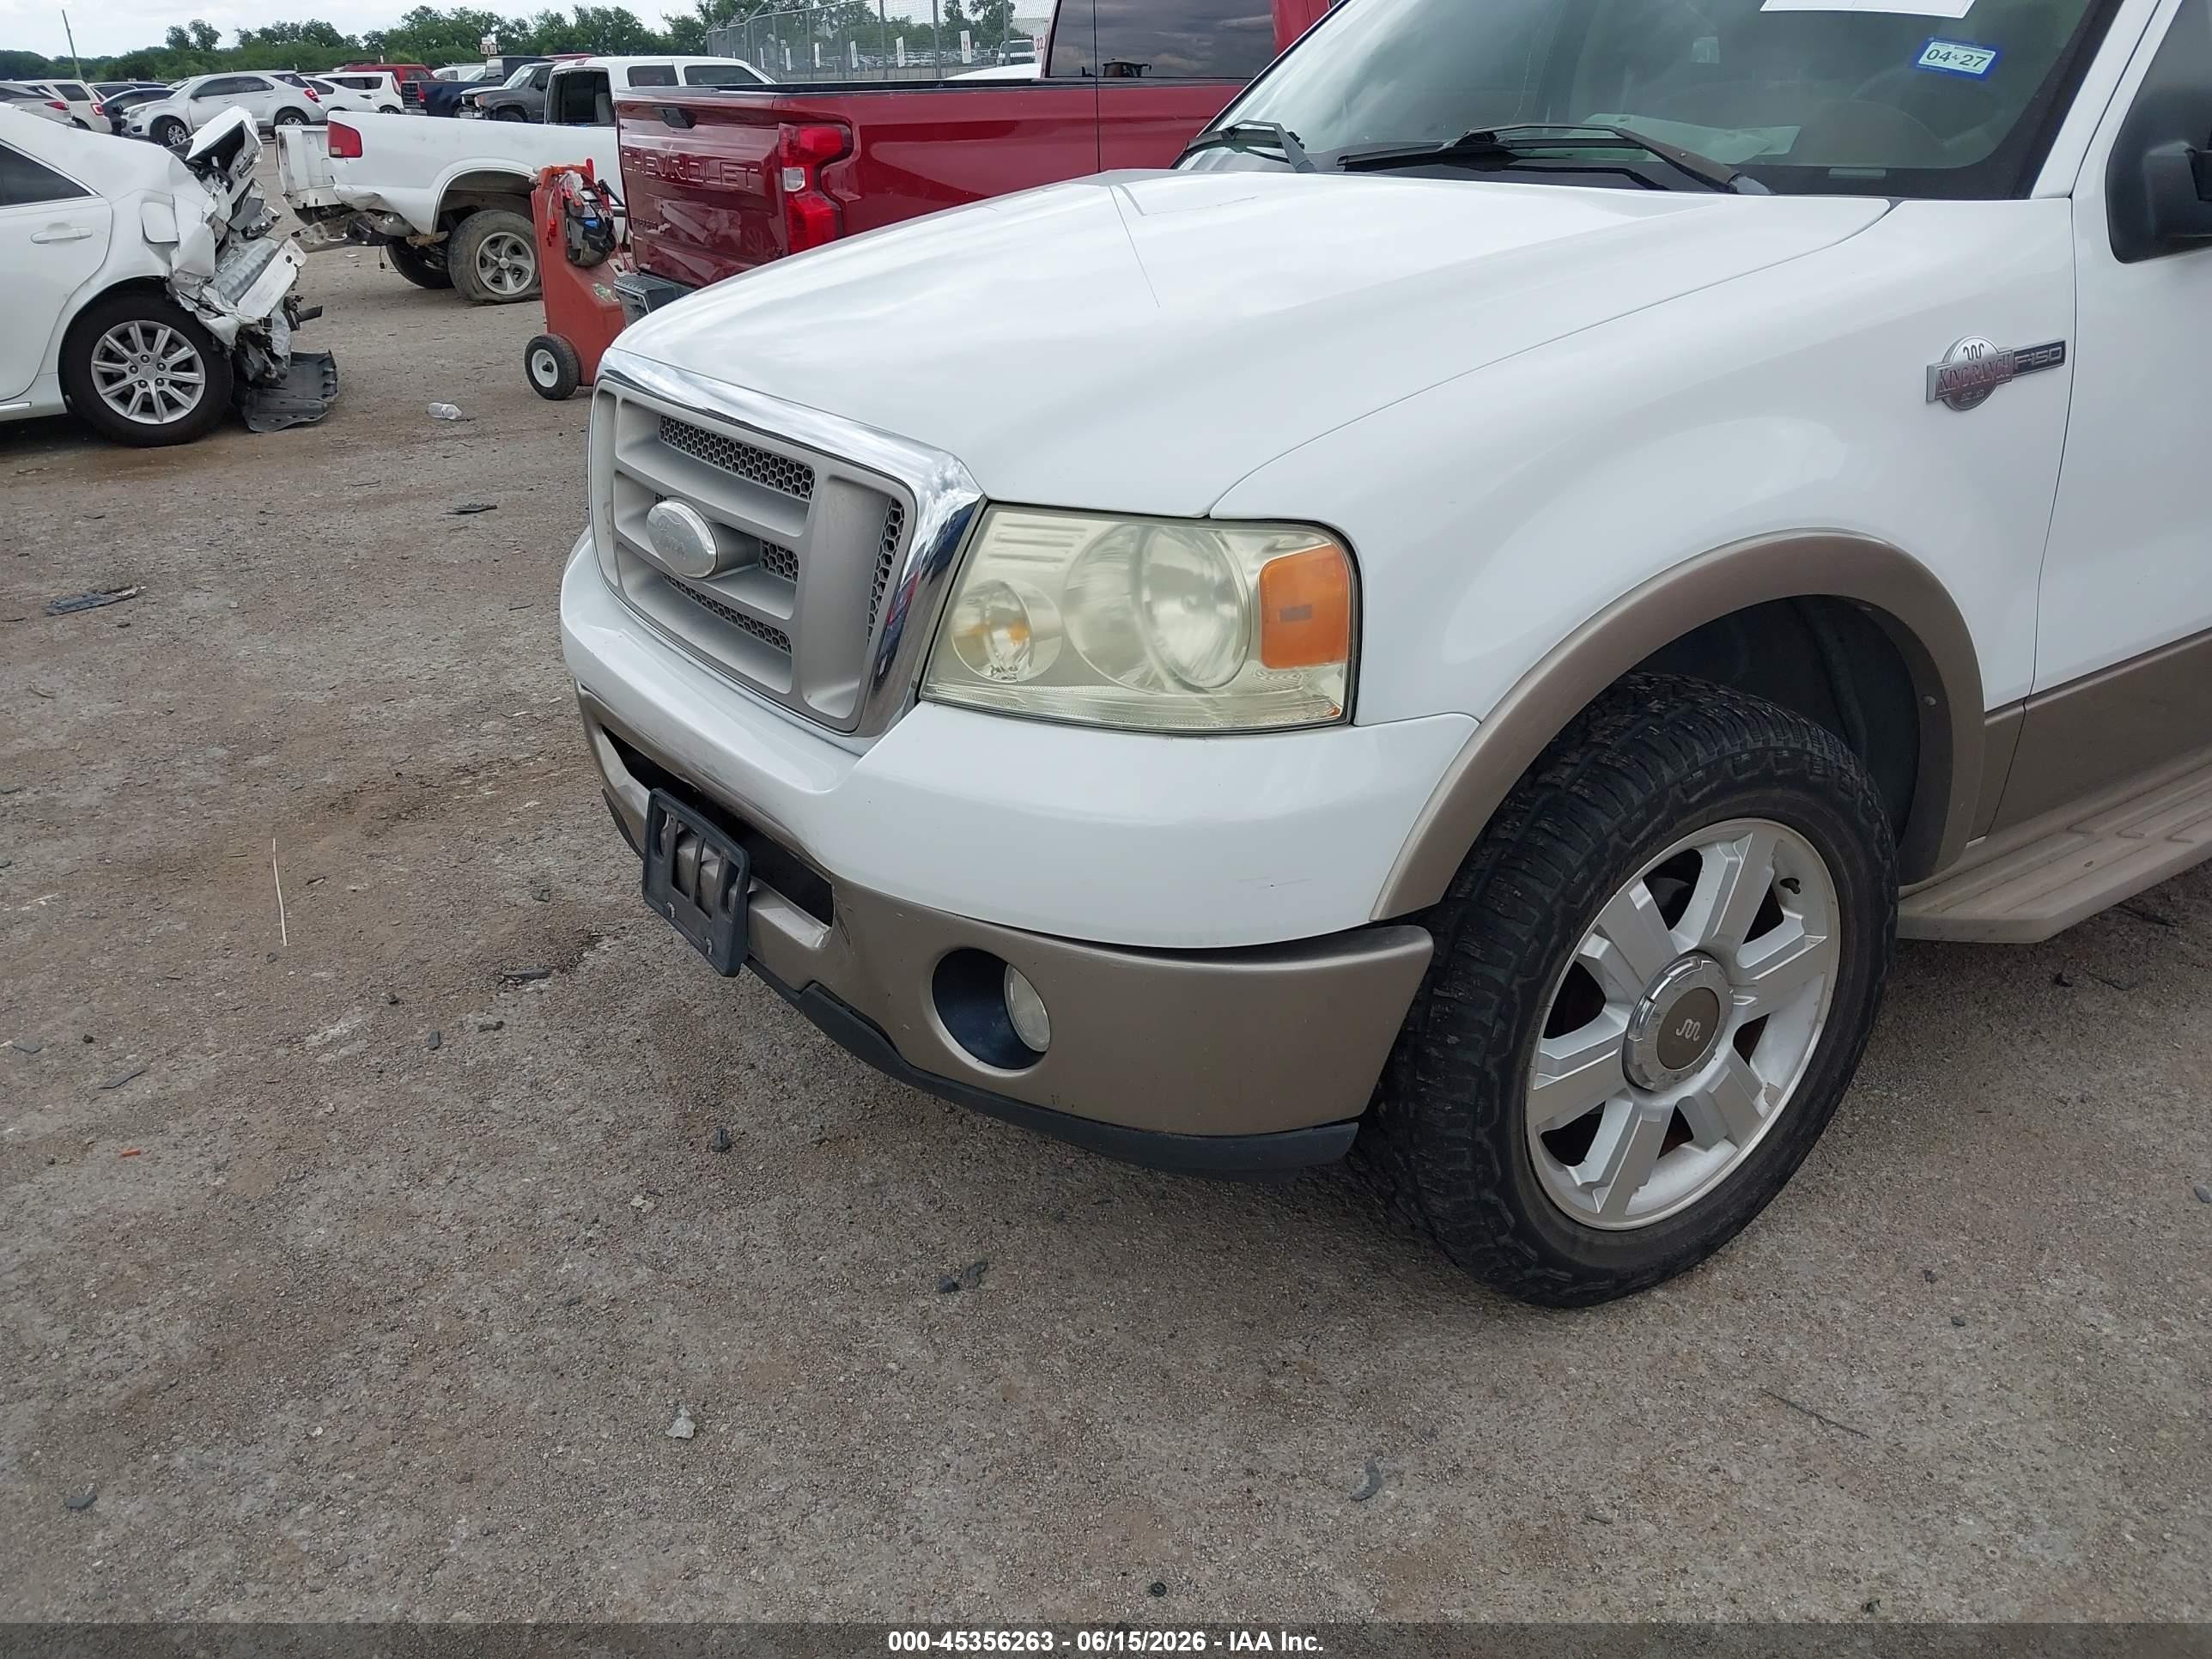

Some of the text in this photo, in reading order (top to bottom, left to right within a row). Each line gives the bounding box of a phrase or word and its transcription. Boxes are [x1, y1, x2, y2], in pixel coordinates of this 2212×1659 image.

[1036, 37, 1044, 51] 22
[1926, 49, 1953, 63] 04
[1959, 54, 1988, 67] 27
[622, 147, 760, 189] CHEVROLET
